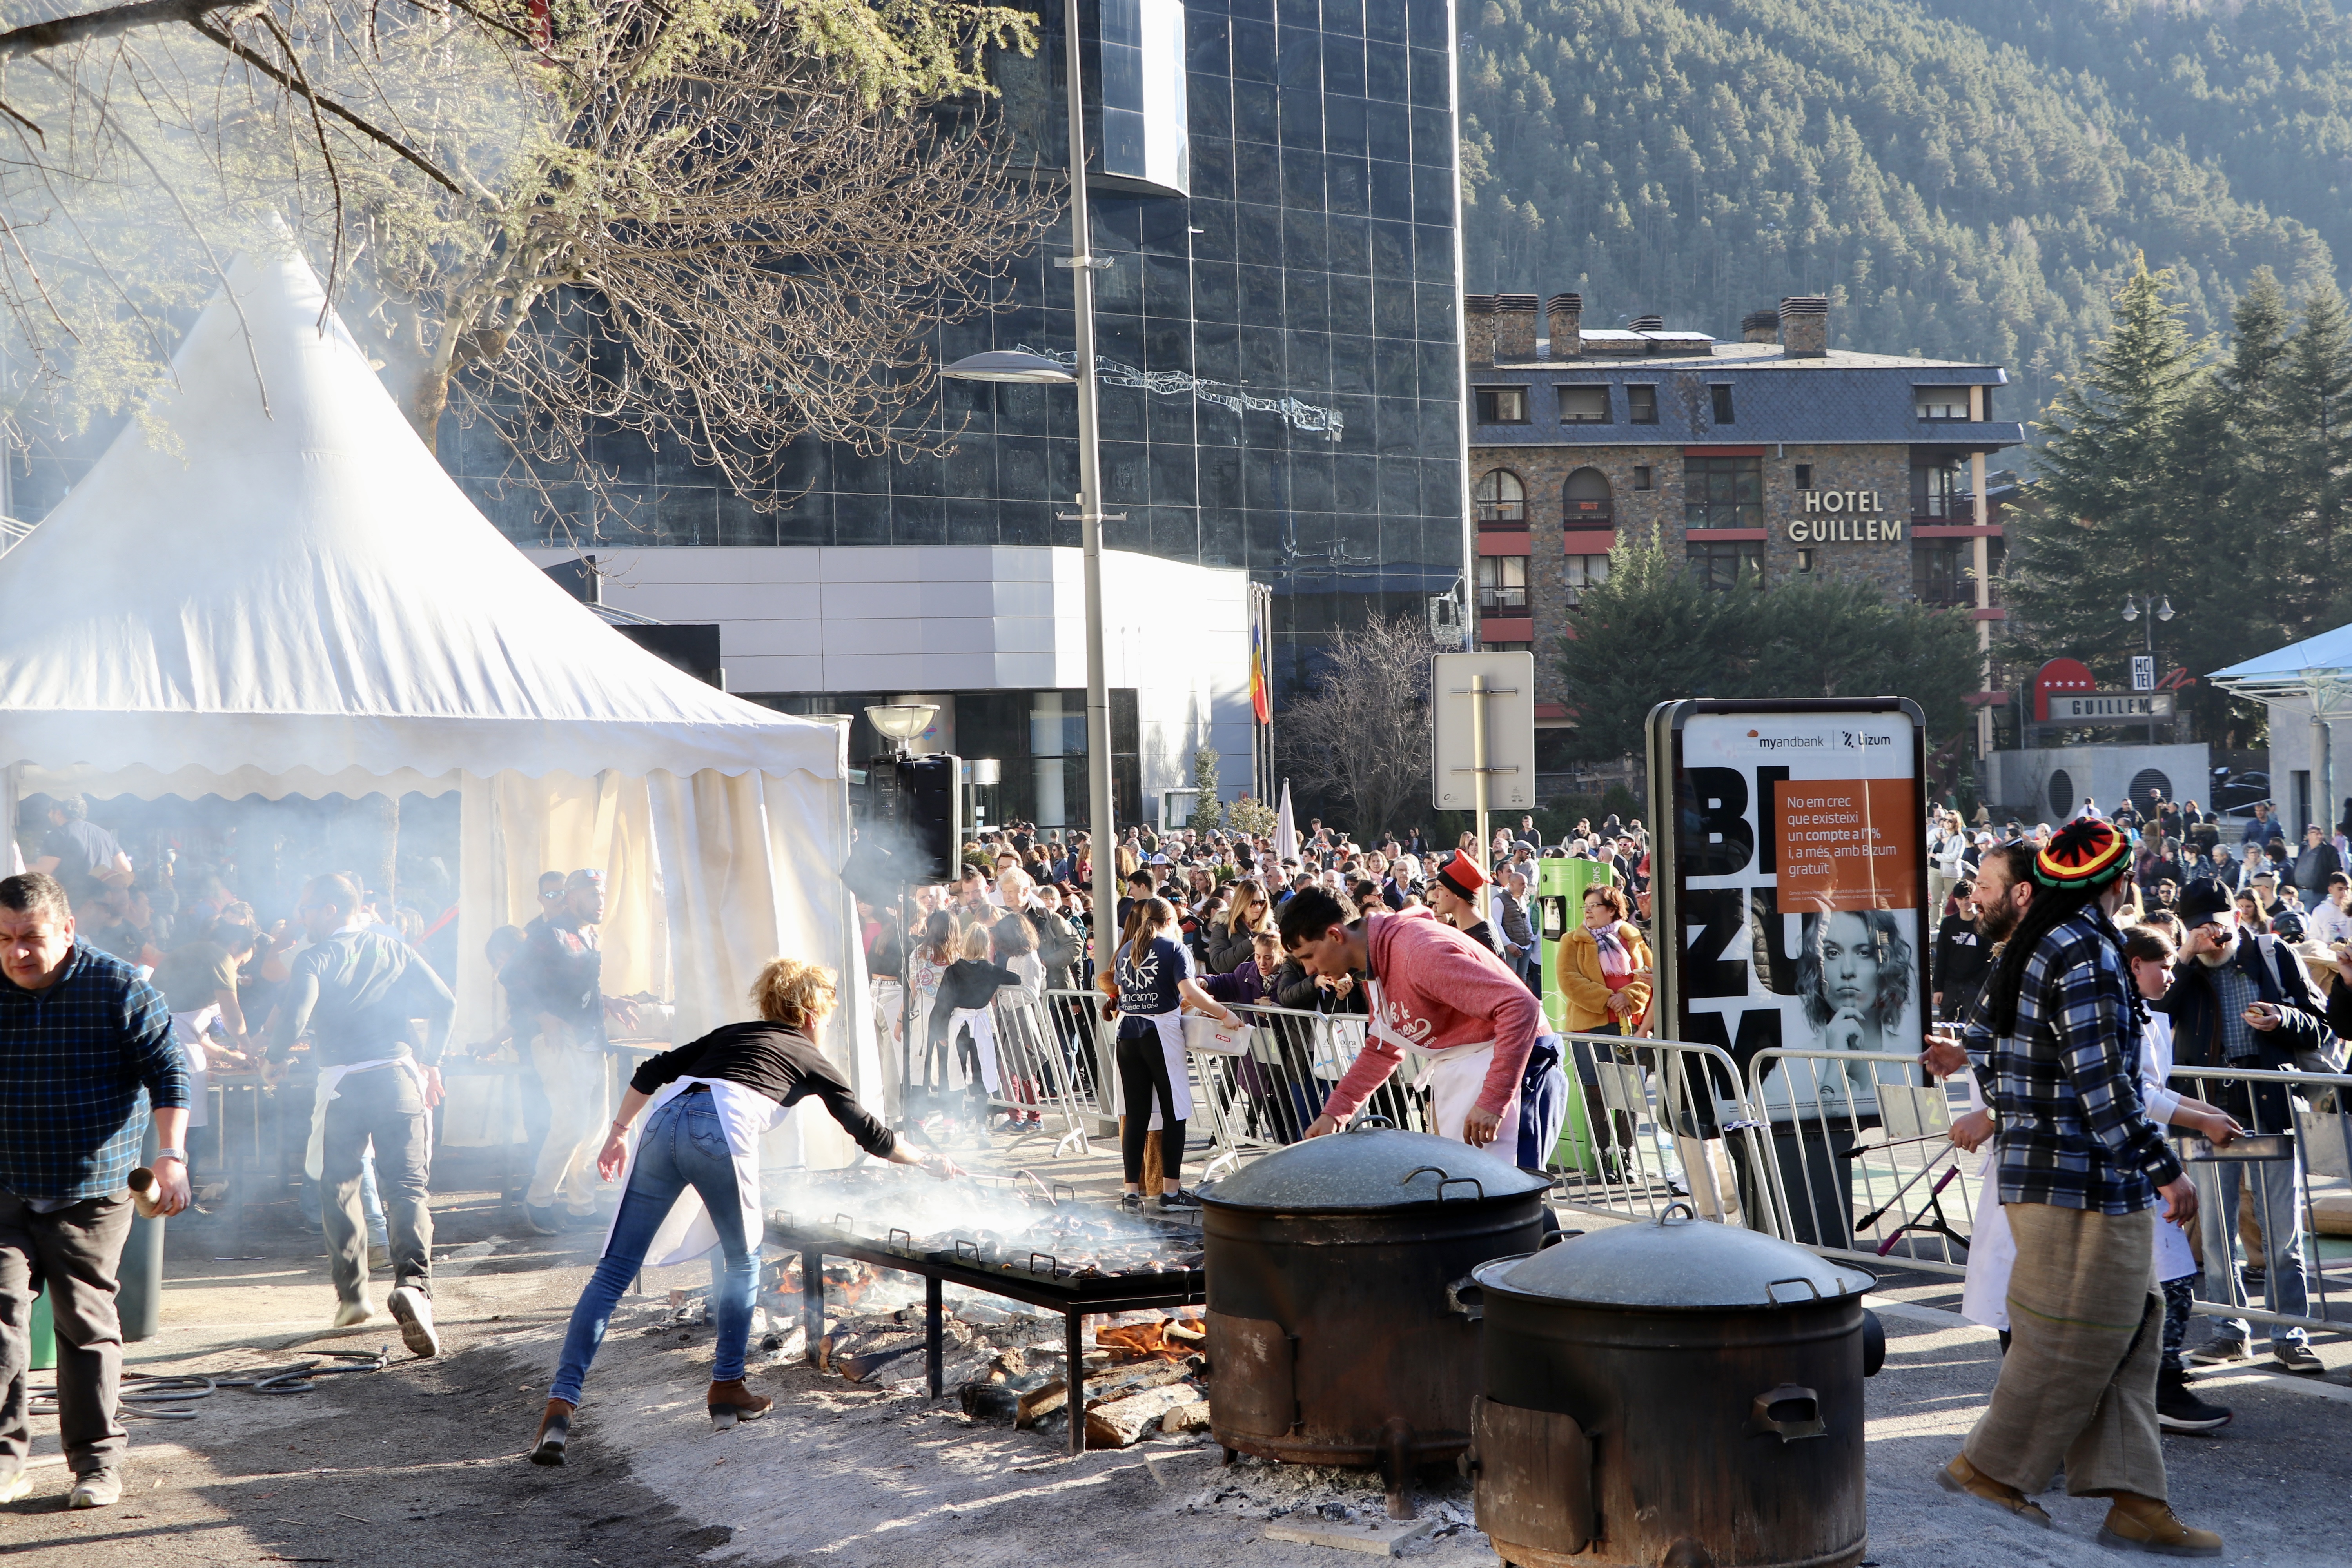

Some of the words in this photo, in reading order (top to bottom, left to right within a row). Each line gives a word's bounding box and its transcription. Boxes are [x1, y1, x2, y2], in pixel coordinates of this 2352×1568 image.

[1806, 491, 1883, 512] HOTEL
[1789, 520, 1901, 541] GUILLEM
[2073, 699, 2149, 714] GUILLEM
[1760, 736, 1824, 750] myandbank
[1858, 733, 1891, 746] bizum
[1787, 797, 1804, 808] No
[1806, 798, 1824, 808] em
[1827, 797, 1851, 807] crec
[1788, 815, 1809, 827] que
[1812, 811, 1858, 824] existeixi
[1788, 831, 1803, 842] un
[1806, 829, 1850, 843] compte
[1852, 830, 1859, 840] a
[1788, 846, 1794, 860] i,
[1796, 848, 1803, 858] a
[1806, 845, 1832, 858] més,
[1834, 844, 1860, 857] amb
[1789, 862, 1829, 878] gratuït
[1122, 993, 1158, 1003] encamp
[1414, 1031, 1426, 1040] DENIM
[1269, 1035, 1277, 1054] 2
[1630, 1074, 1641, 1098] 2
[1926, 1097, 1941, 1125] 2
